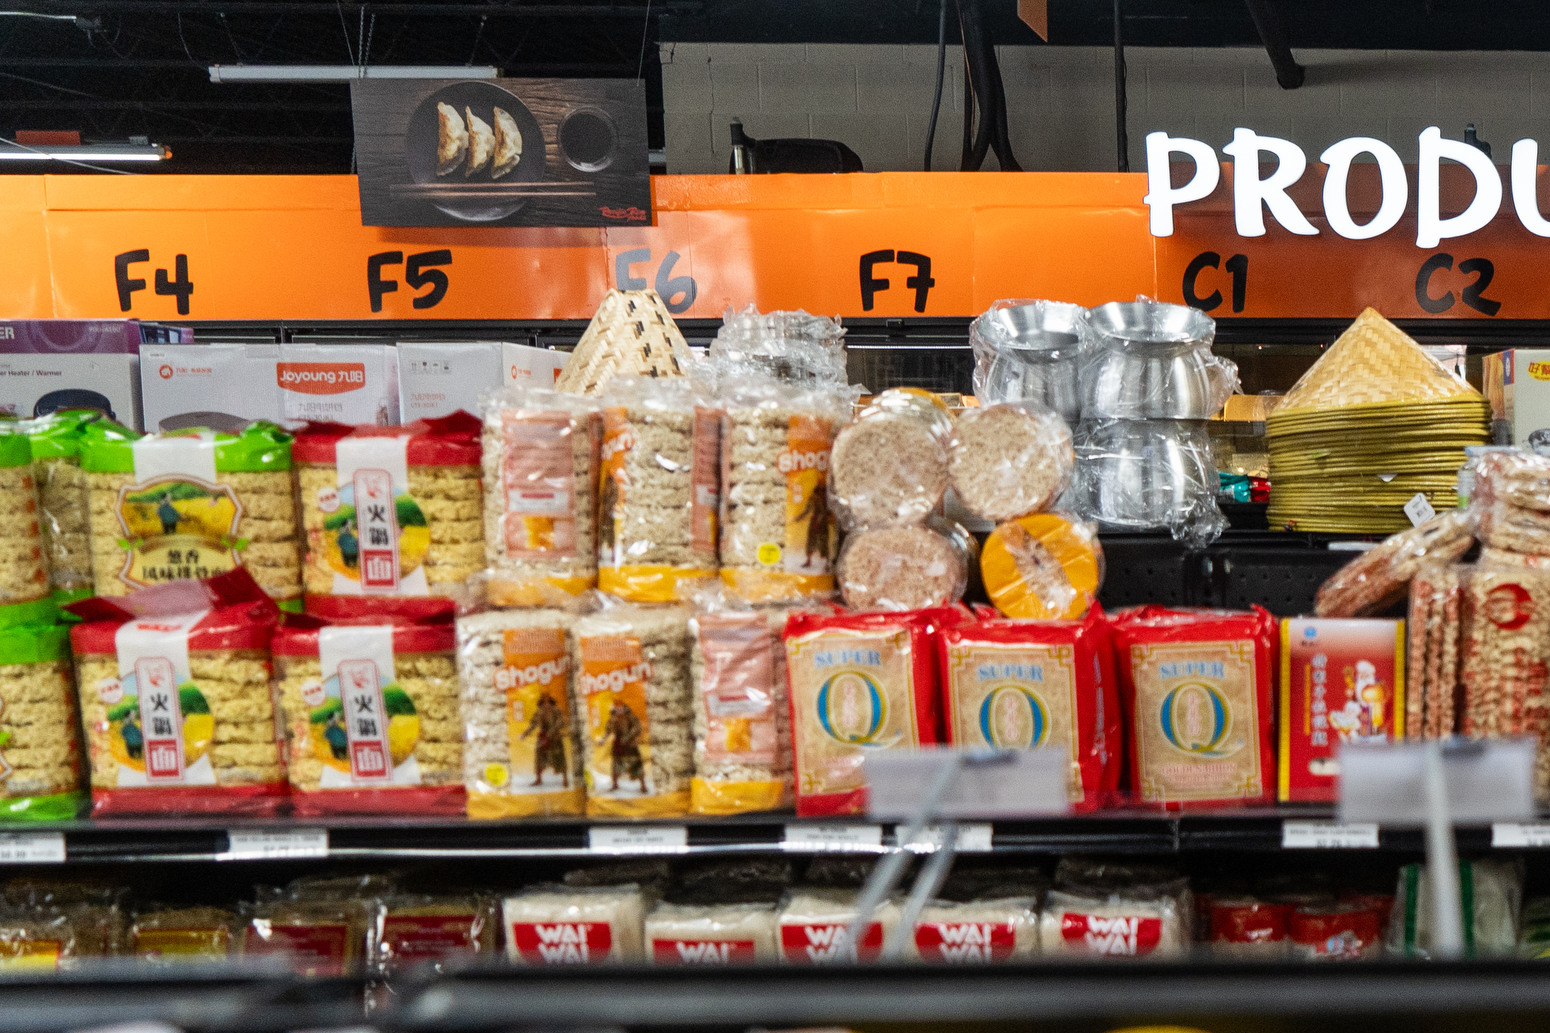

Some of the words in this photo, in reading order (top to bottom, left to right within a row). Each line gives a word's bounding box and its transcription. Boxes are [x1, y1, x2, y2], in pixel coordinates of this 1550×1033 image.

[115, 249, 194, 315] F4
[366, 249, 453, 313] F5
[615, 249, 697, 313] F6
[859, 249, 935, 312] F7
[1182, 251, 1248, 312] C1
[1415, 253, 1501, 316] C2
[280, 370, 336, 384] Joyoung
[778, 450, 829, 472] shog
[814, 650, 882, 667] SUPER
[494, 655, 571, 689] shogun
[580, 662, 650, 694] shogun
[976, 665, 1044, 682] SUPER
[1159, 661, 1225, 679] SUPER
[817, 671, 902, 750] Q
[979, 686, 1051, 750] Q
[1161, 682, 1245, 759] Q
[536, 925, 588, 943] WAI
[938, 924, 992, 943] WAI
[1085, 916, 1138, 935] WAI
[538, 944, 589, 964] WAI
[677, 942, 729, 963] WAI
[939, 944, 992, 964] WAI
[1086, 935, 1138, 955] WAI
